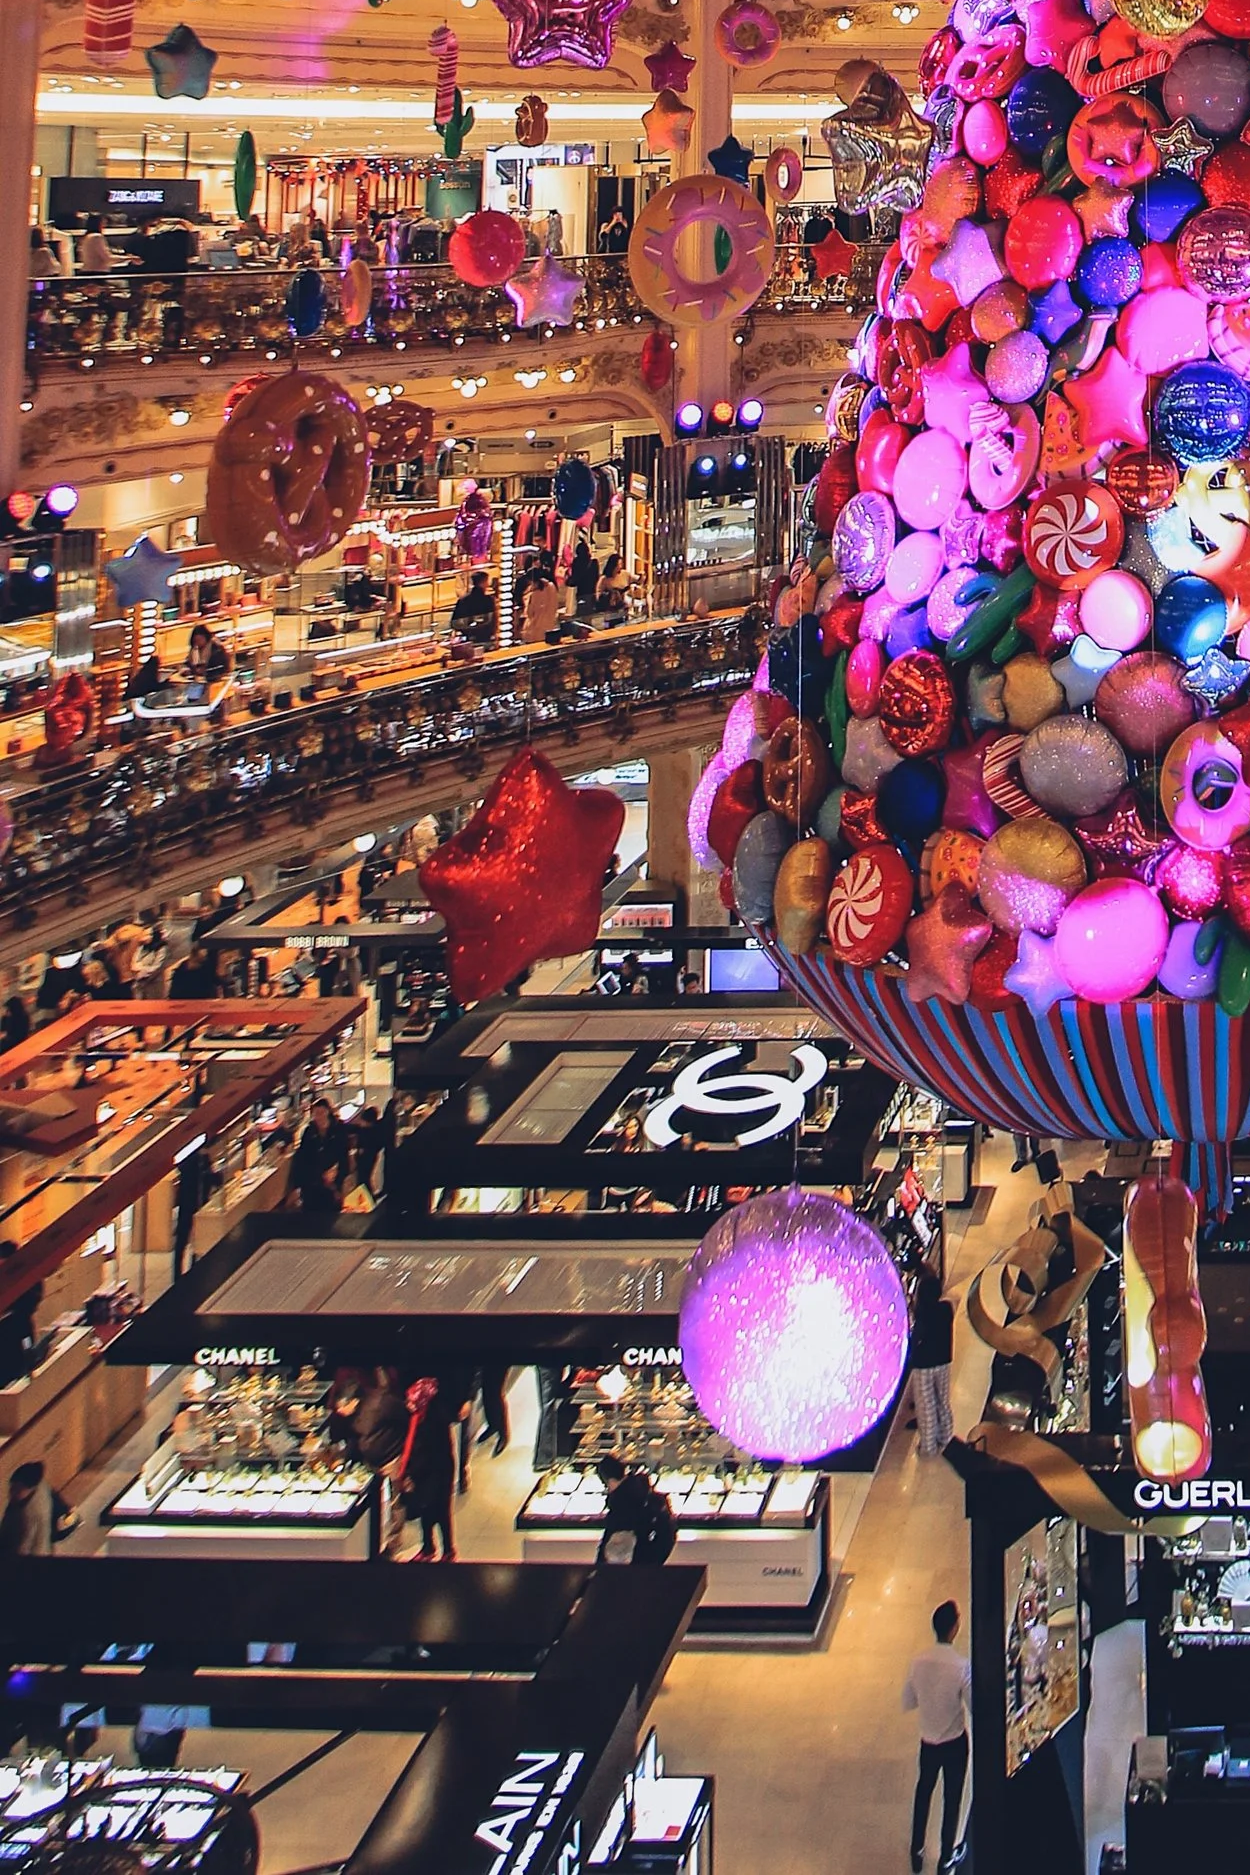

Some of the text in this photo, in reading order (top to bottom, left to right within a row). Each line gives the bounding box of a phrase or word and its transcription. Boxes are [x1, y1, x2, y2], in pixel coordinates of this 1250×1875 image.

[285, 936, 350, 948] BOBBI BROWN
[194, 1346, 281, 1365] CHANEL
[622, 1346, 683, 1366] CHAN
[761, 1565, 804, 1577] CHANEL
